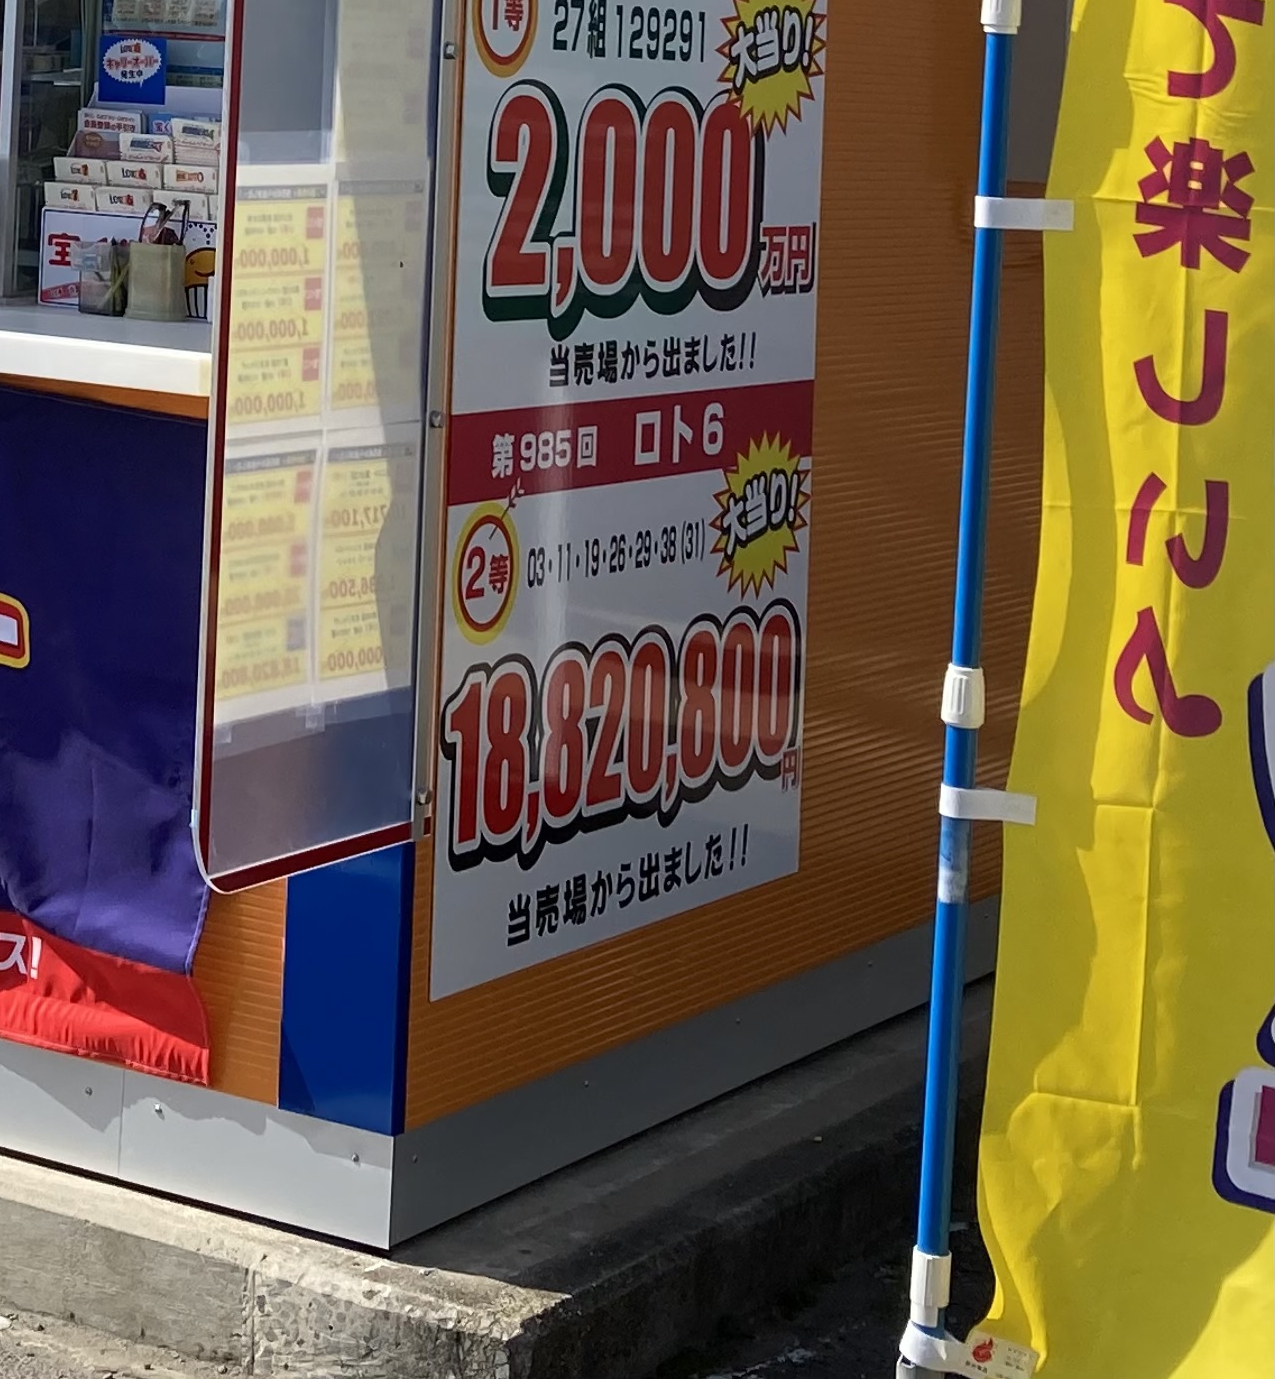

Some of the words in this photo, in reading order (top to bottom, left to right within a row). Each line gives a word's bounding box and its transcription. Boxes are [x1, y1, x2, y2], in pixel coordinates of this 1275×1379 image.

[730, 5, 815, 93] 大当り!
[489, 89, 757, 324] 2,000
[759, 224, 815, 295] 万円
[549, 332, 757, 387] 当売場から出ました!!
[492, 425, 598, 479] 第985回
[635, 402, 724, 466] ロト6
[722, 468, 800, 561] 大当り!
[464, 548, 511, 600] 2等
[444, 605, 799, 863] 18,820,800
[506, 823, 750, 947] 当売場から出ました!!
